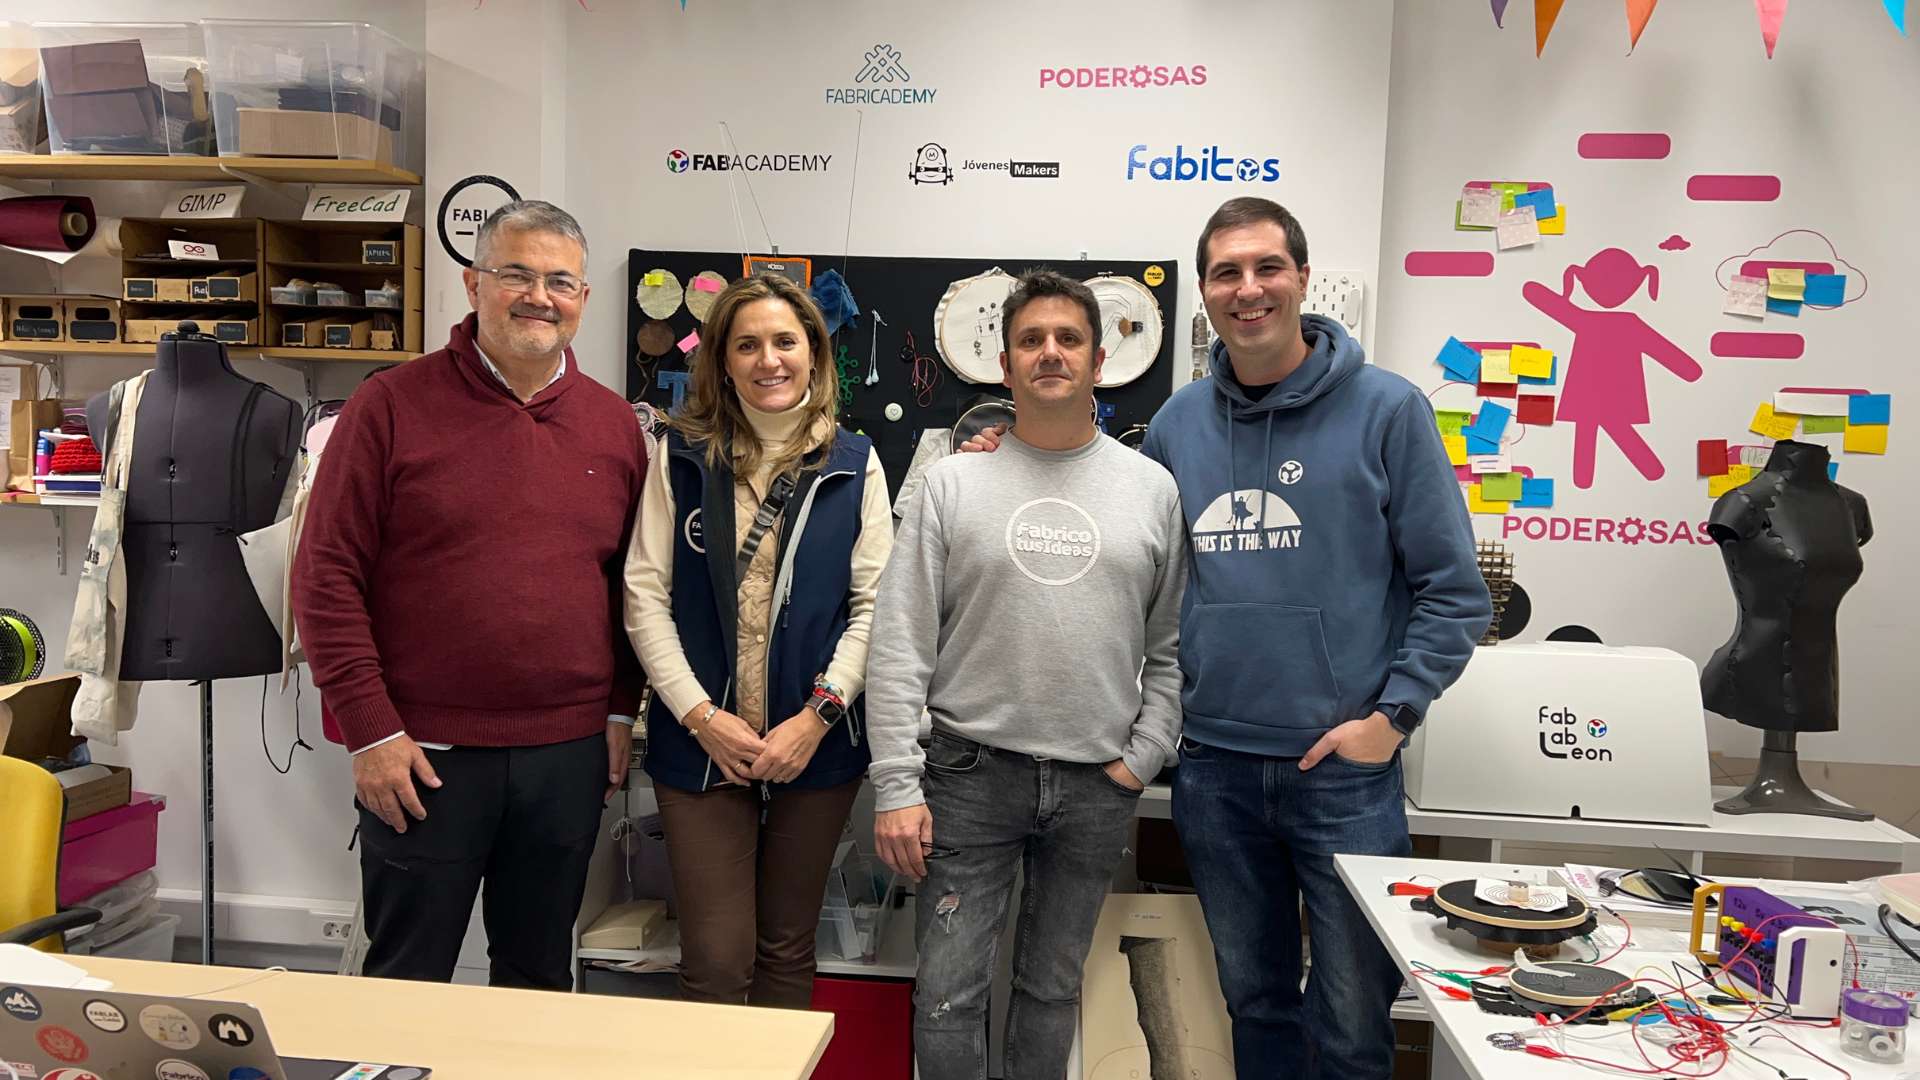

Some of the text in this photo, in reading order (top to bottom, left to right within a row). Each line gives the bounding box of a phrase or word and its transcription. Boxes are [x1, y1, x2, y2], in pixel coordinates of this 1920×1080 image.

[1040, 65, 1207, 89] PODEROSAS
[826, 88, 937, 104] FABRICADEMY
[962, 159, 1058, 176] Jóvenes Makers
[178, 192, 227, 213] GIMP
[312, 193, 401, 213] FreeCad
[1016, 522, 1092, 544] Fabrico
[1193, 535, 1217, 553] THIS
[1220, 534, 1232, 552] IS
[1267, 529, 1302, 549] WAY
[1538, 705, 1577, 725] Fab
